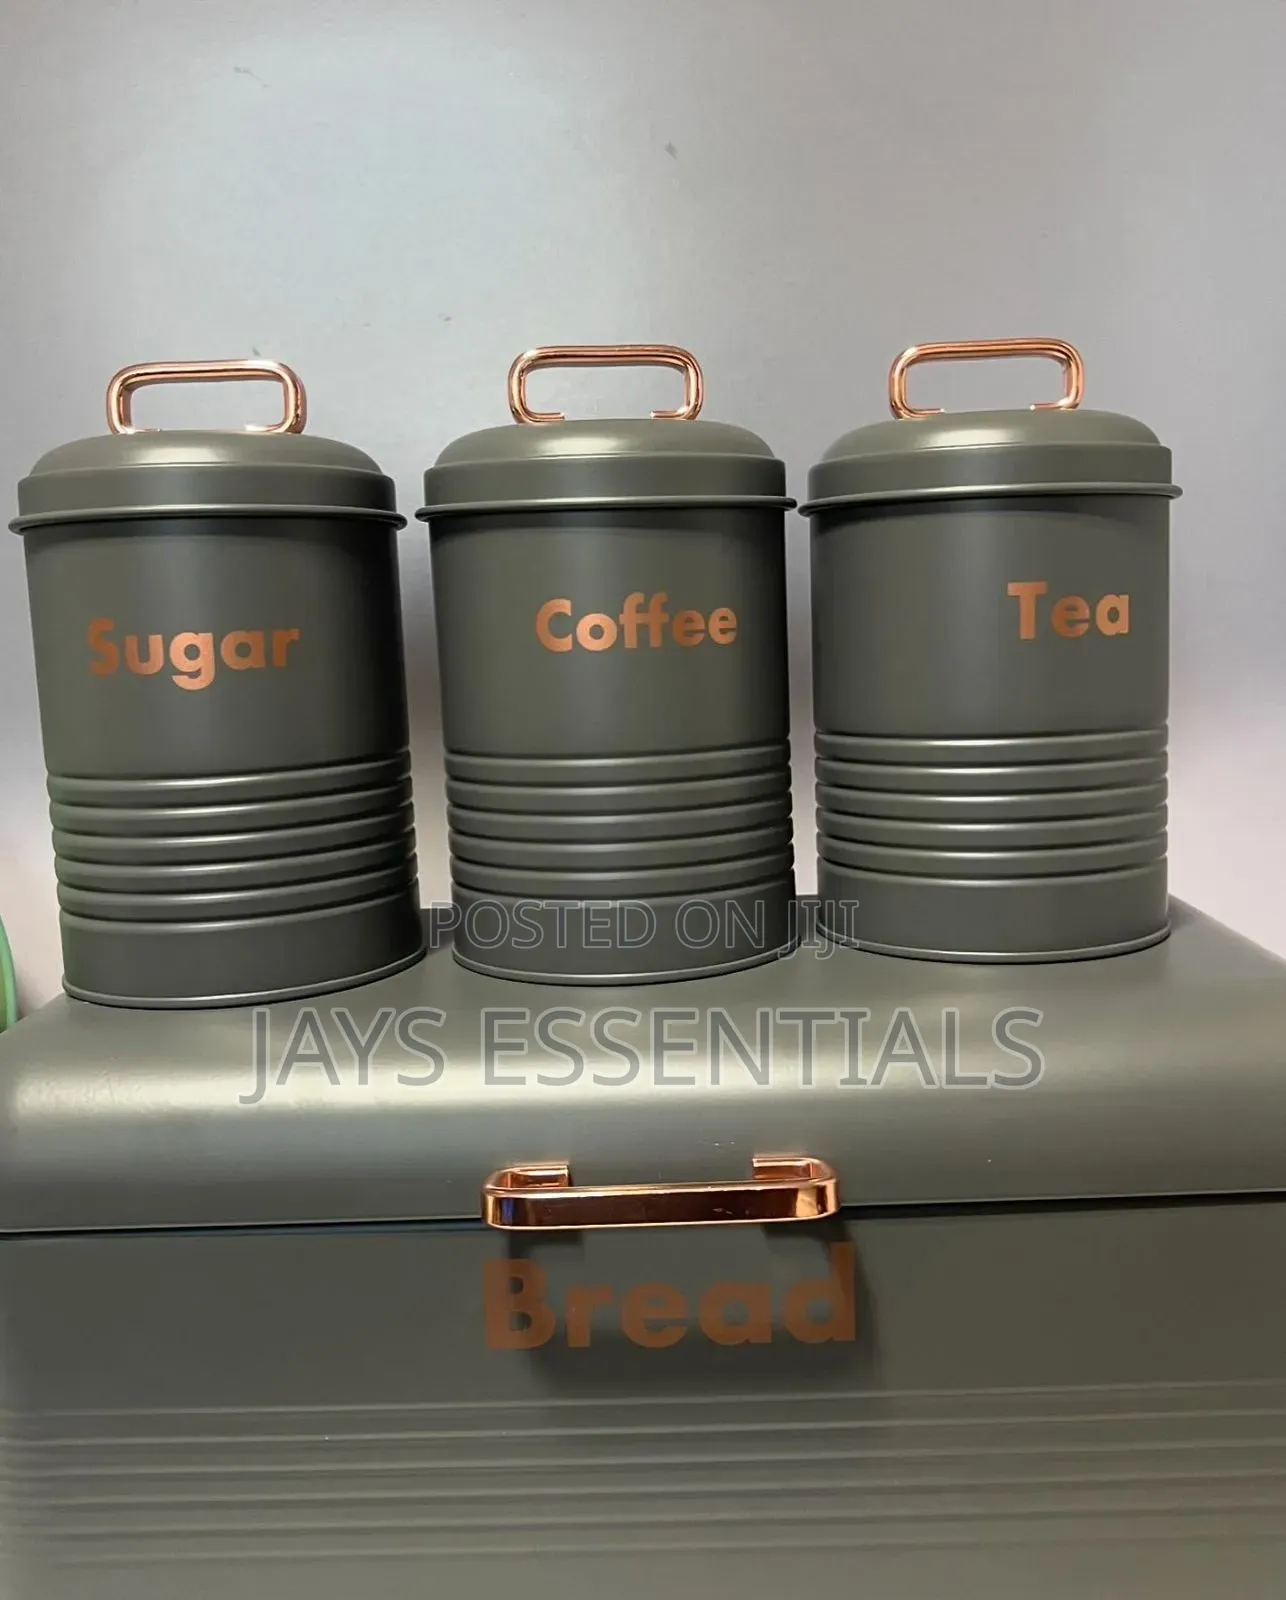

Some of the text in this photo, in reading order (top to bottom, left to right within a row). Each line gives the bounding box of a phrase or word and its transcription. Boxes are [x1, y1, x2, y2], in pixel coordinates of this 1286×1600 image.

[535, 591, 737, 653] Coffee
[1007, 580, 1131, 640] Tea
[87, 617, 300, 691] Sugar
[483, 1241, 856, 1349] Bread
